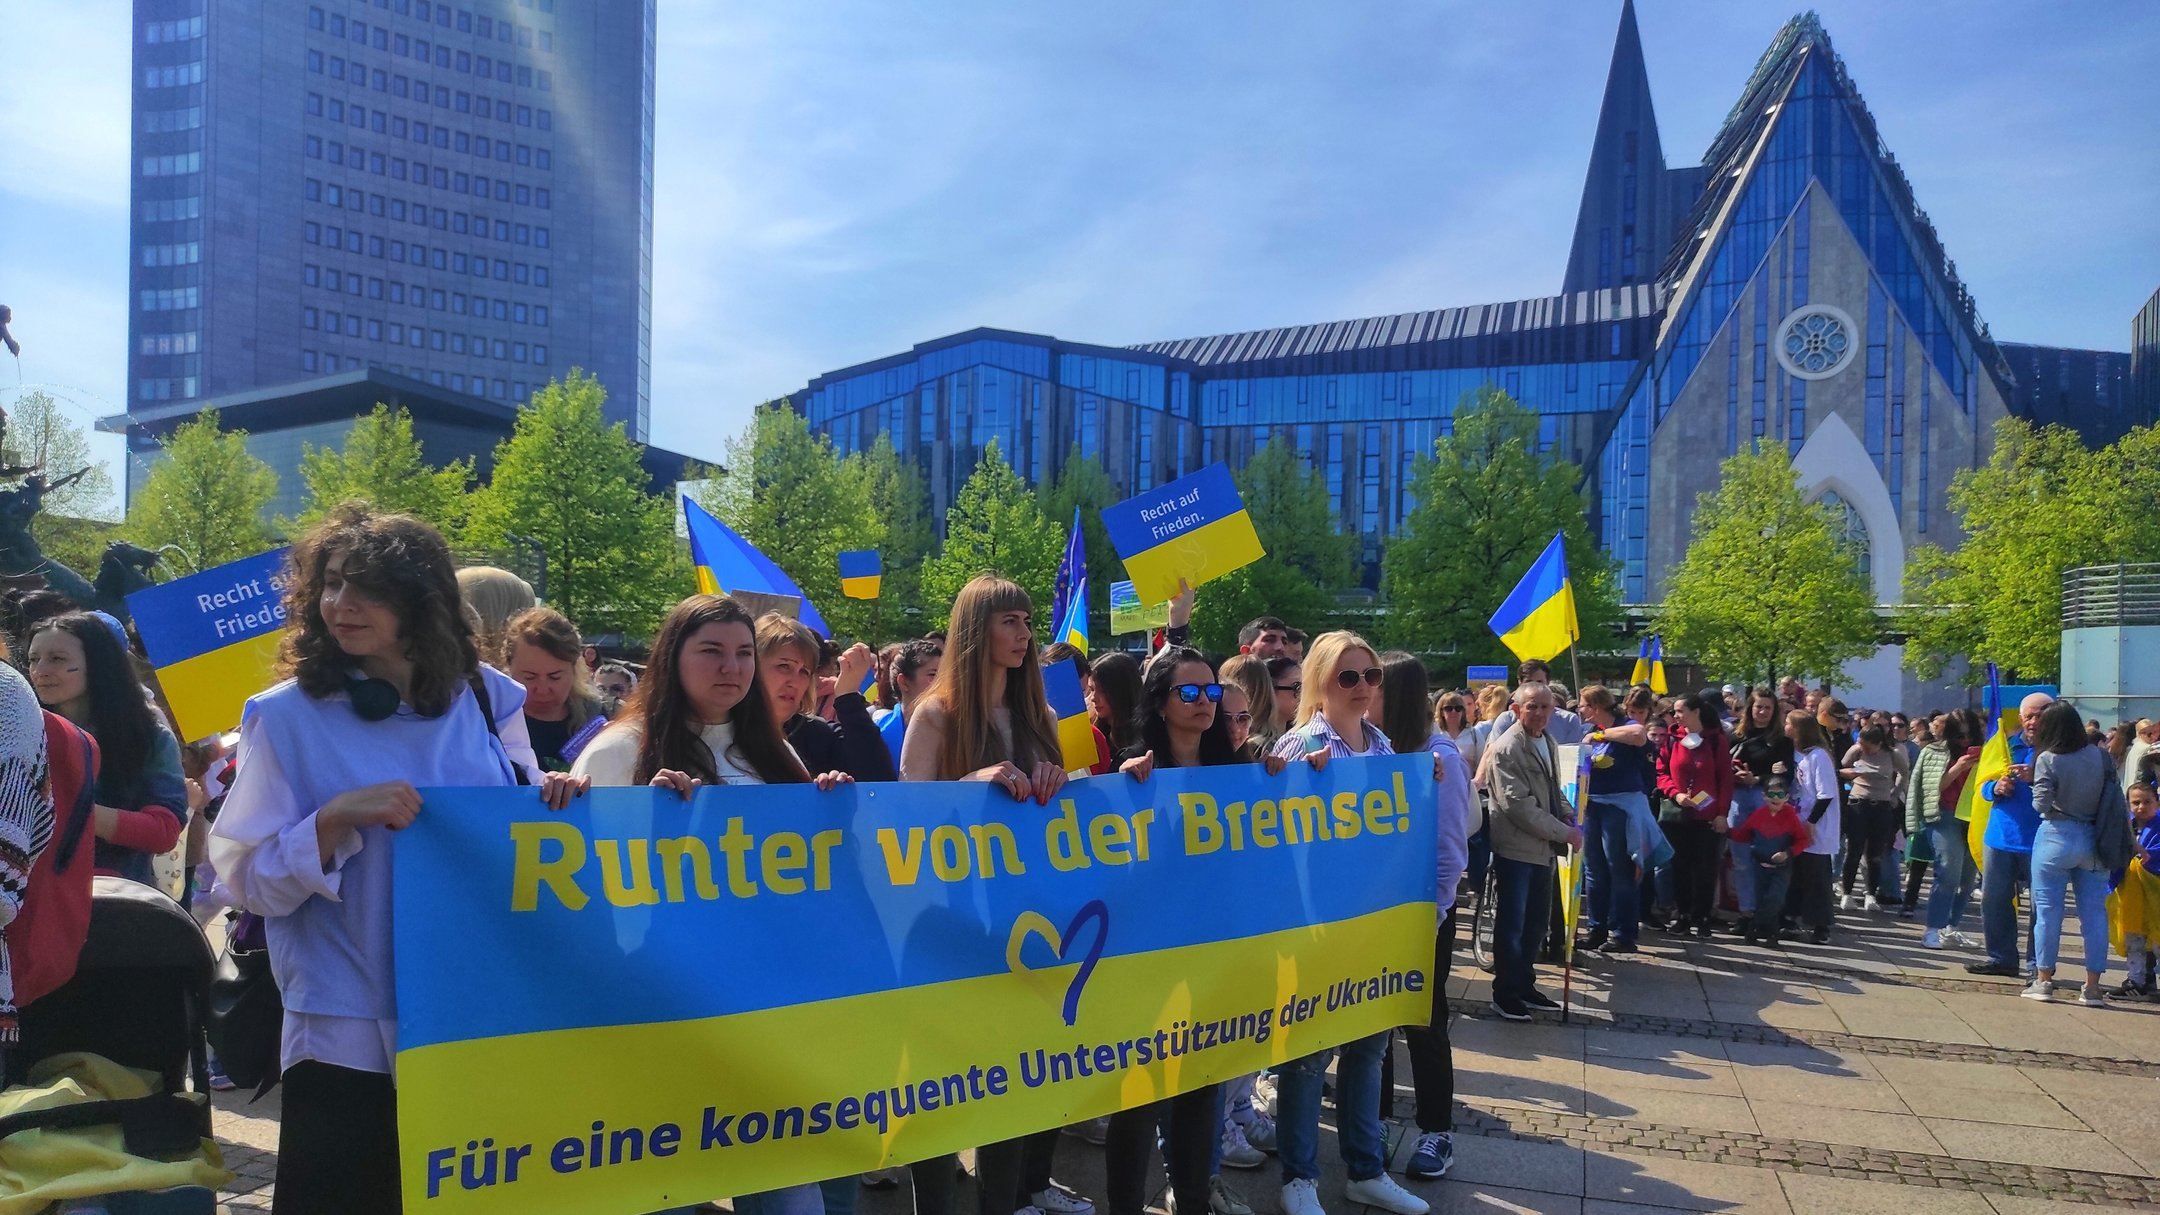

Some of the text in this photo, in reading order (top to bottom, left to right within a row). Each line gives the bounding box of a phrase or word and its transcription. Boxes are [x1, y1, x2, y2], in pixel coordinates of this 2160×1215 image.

[1140, 487, 1200, 523] Recht auf
[1151, 512, 1205, 540] Frieden.
[197, 578, 264, 614] Recht
[214, 603, 287, 639] Friede
[510, 771, 1411, 912] Runter von der Bremse!
[427, 965, 1425, 1200] Für eine konsequente Unterstützung der Ukraine
